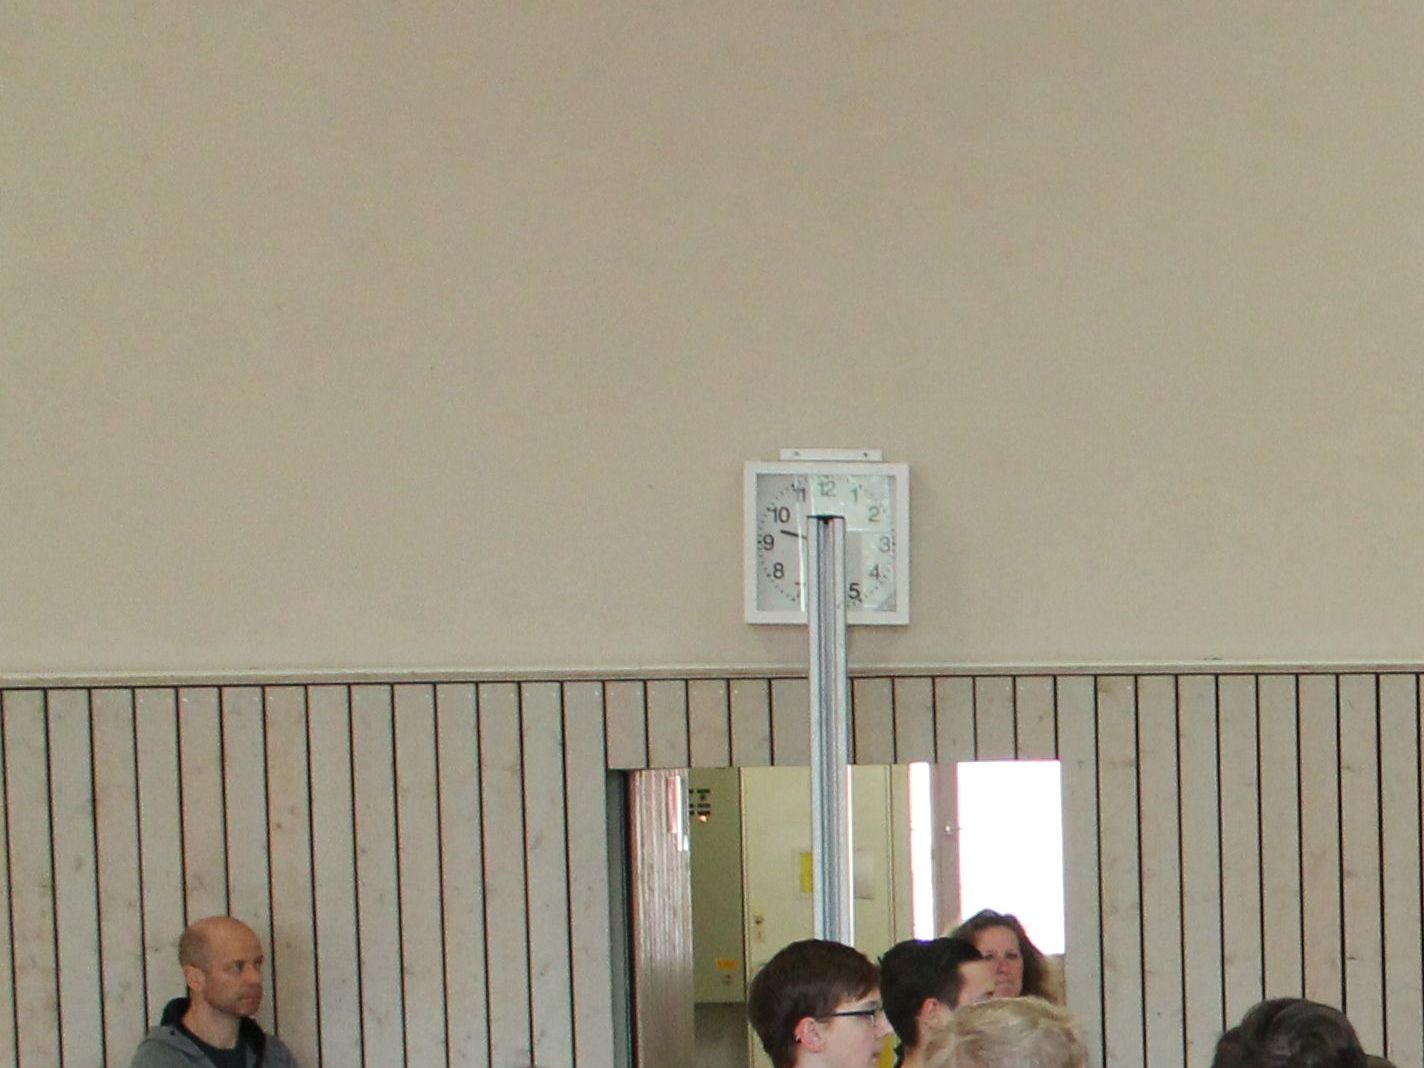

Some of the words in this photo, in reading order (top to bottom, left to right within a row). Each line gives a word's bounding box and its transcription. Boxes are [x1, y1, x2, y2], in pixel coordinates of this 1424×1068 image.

[818, 480, 836, 497] 12
[851, 488, 858, 502] 1
[770, 506, 791, 524] 10
[868, 506, 880, 522] 2
[763, 534, 775, 551] 9
[880, 536, 890, 552] 3
[773, 562, 784, 579] 8
[869, 564, 880, 580] 4
[848, 582, 861, 599] 5
